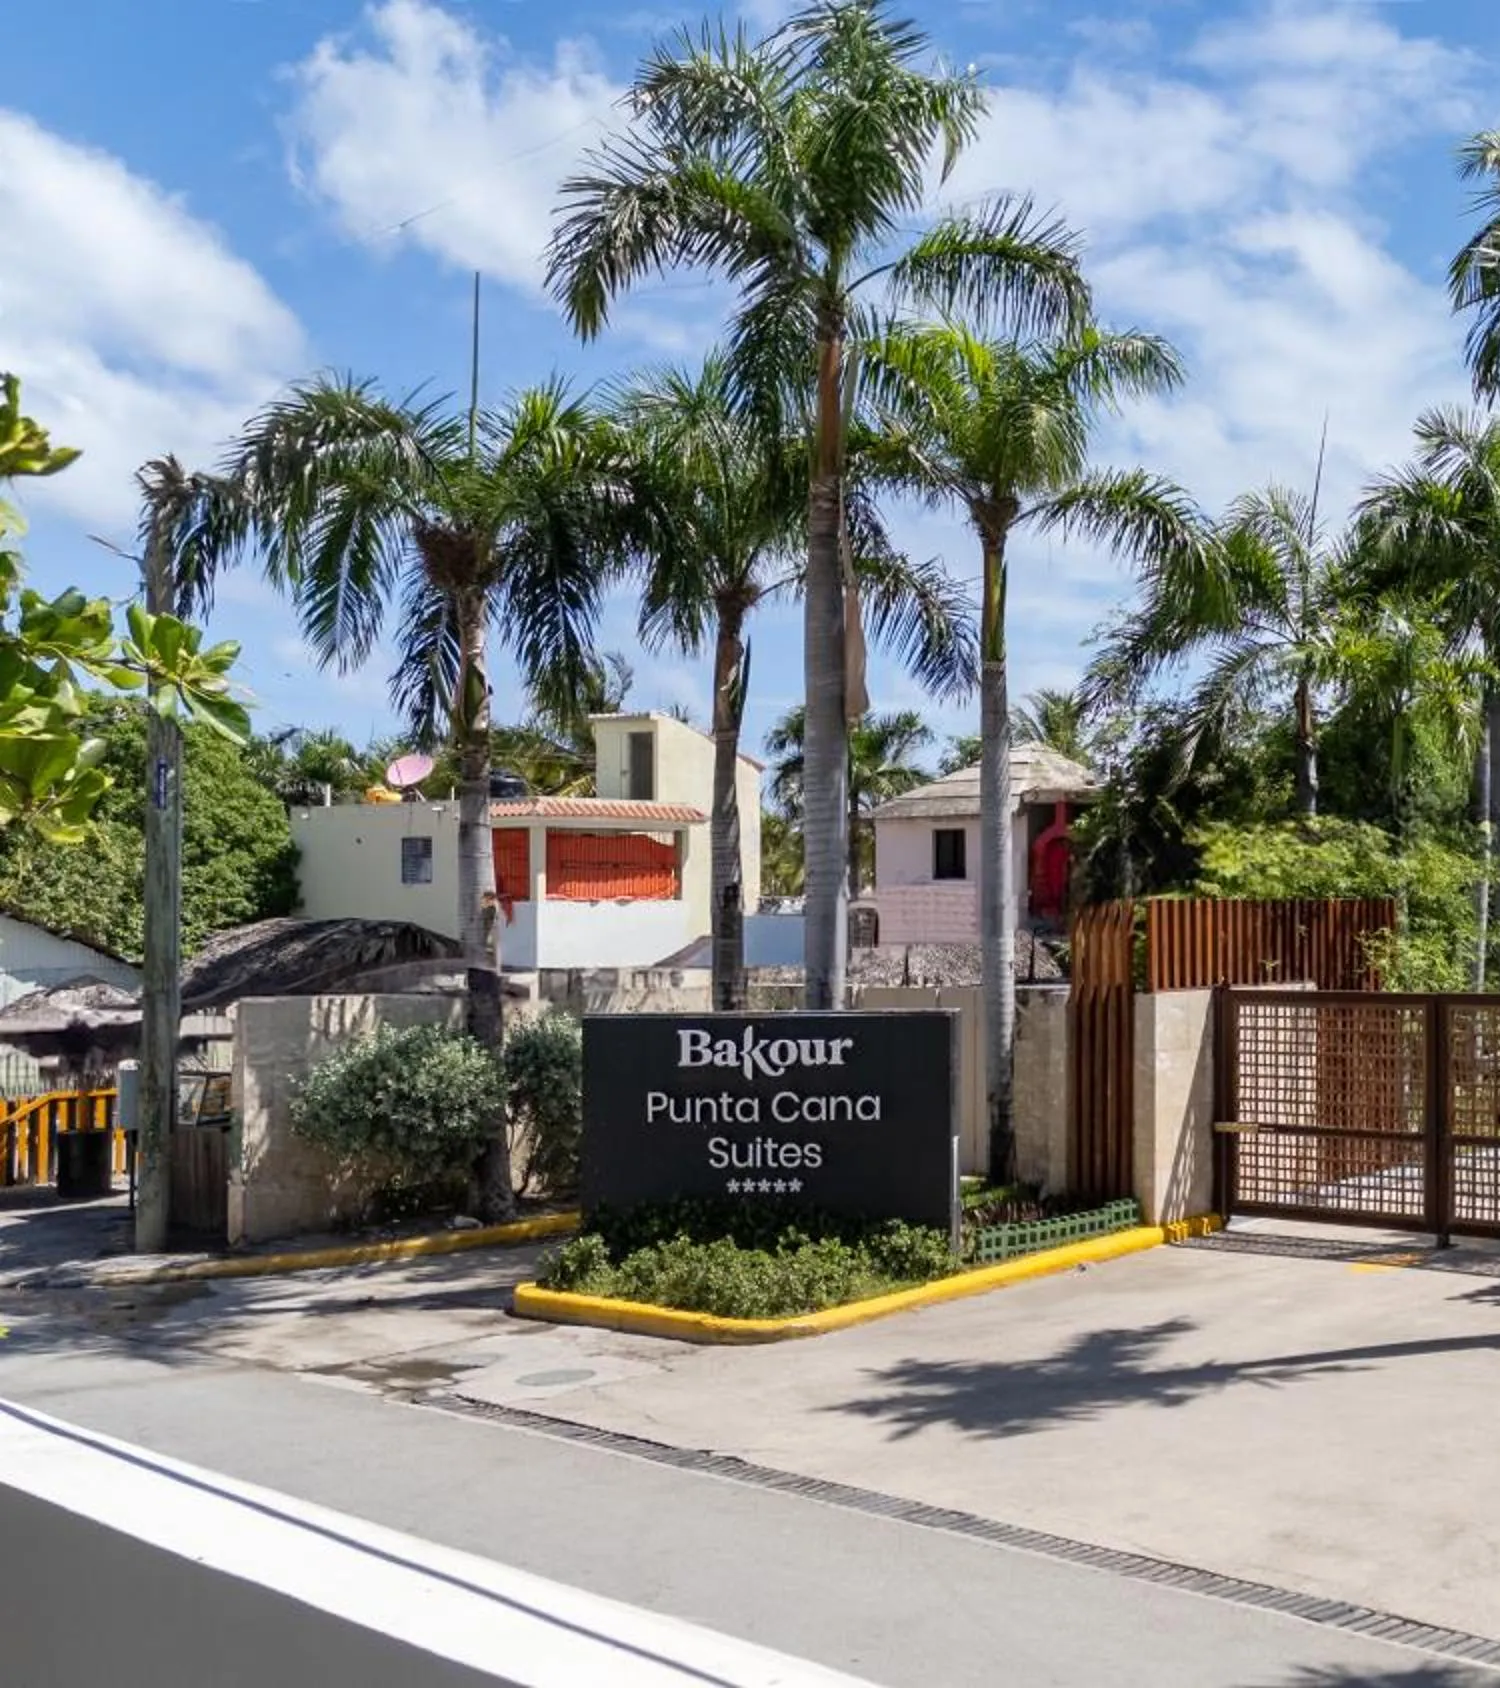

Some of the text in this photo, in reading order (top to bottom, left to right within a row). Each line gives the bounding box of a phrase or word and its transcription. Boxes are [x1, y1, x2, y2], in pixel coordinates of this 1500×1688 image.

[677, 1025, 854, 1081] Bakour
[647, 1091, 881, 1123] Punta Cana
[707, 1136, 822, 1168] Suites
